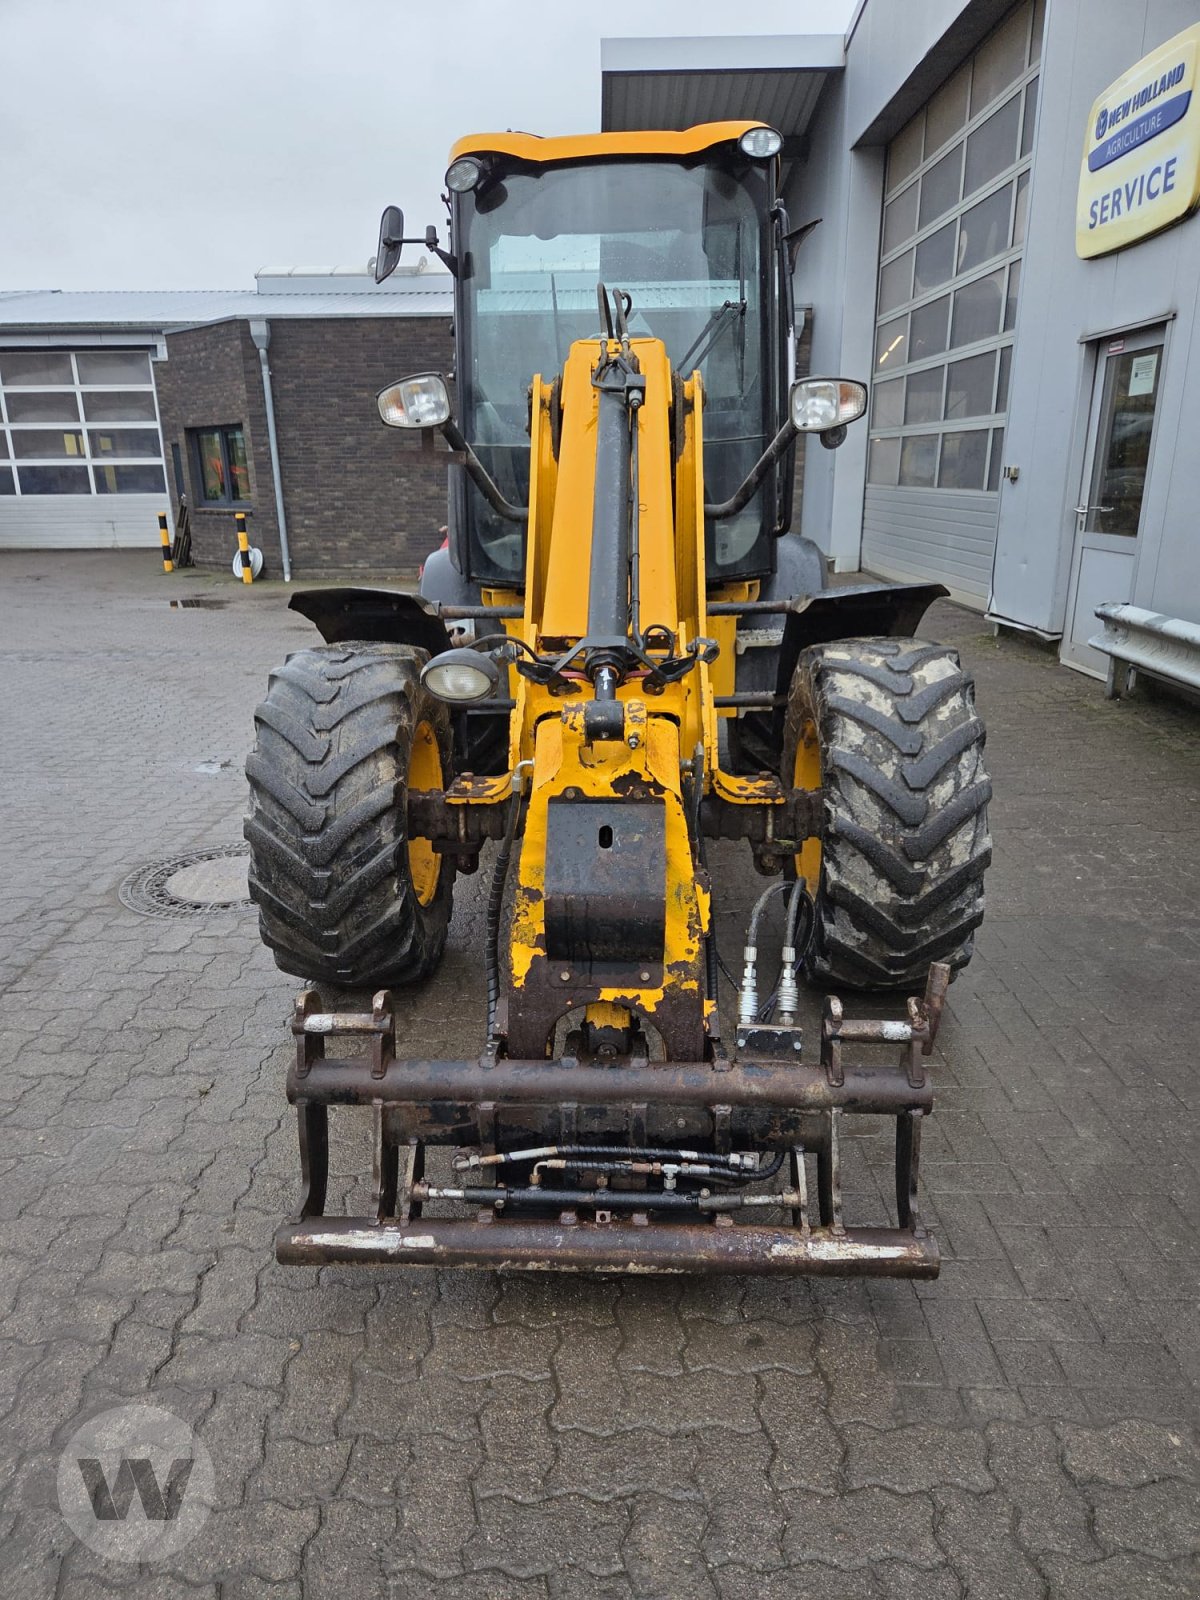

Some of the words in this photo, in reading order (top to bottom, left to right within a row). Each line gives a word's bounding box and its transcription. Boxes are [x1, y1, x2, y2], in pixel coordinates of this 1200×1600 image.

[1108, 98, 1132, 130] NEW
[1131, 62, 1185, 113] HOLLAND
[1105, 111, 1162, 158] AGRICULTURE
[1088, 157, 1178, 230] SERVICE
